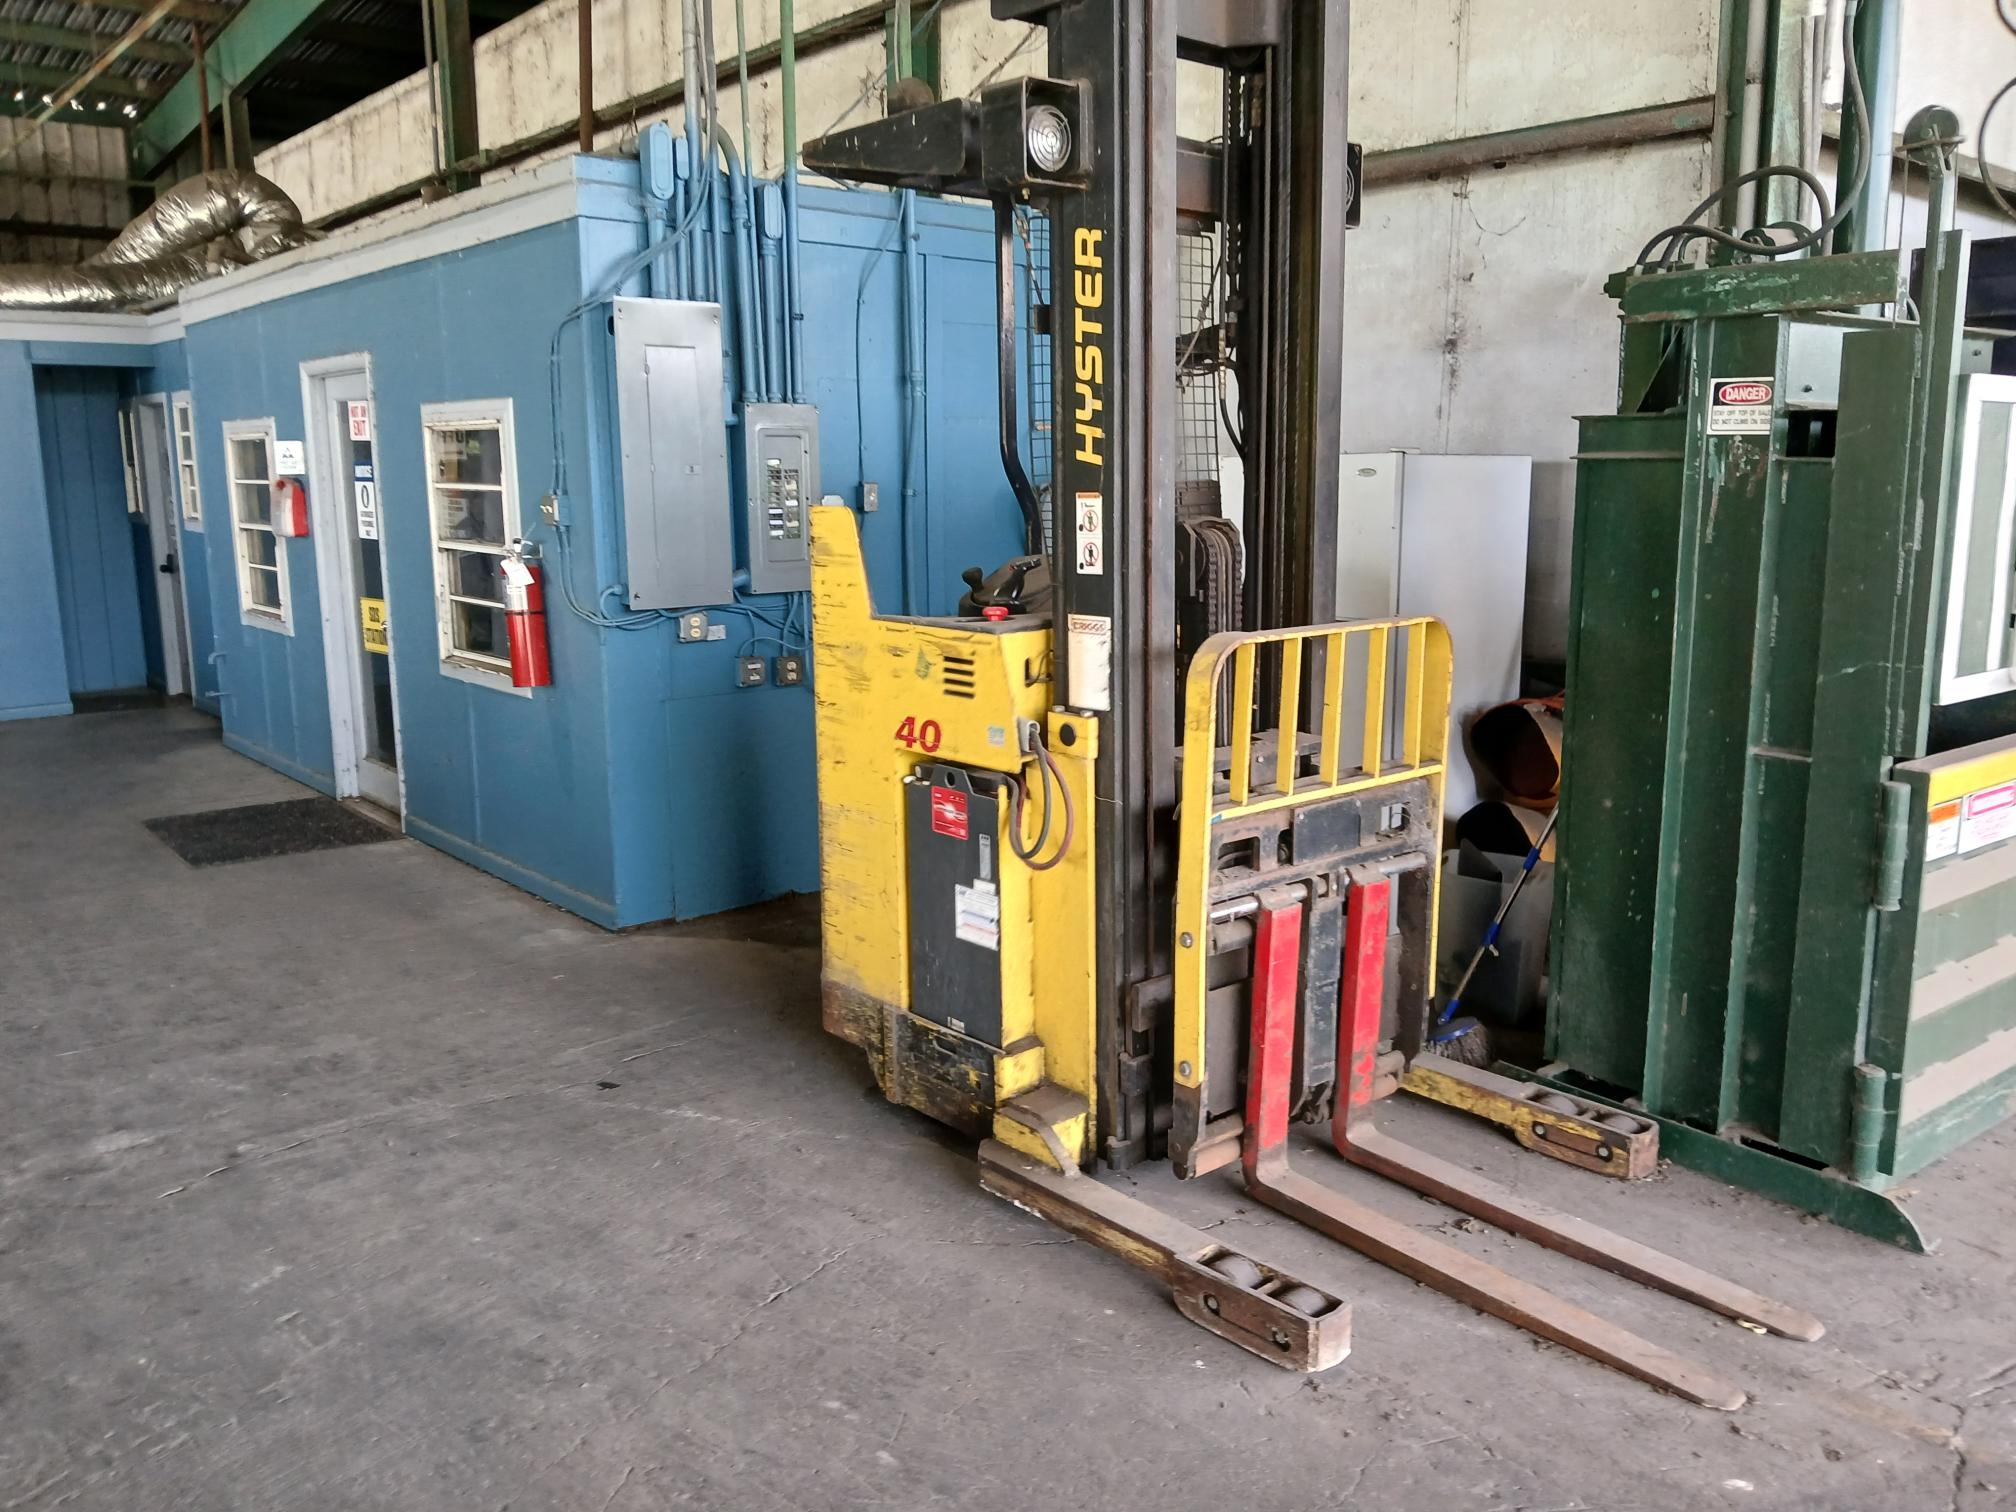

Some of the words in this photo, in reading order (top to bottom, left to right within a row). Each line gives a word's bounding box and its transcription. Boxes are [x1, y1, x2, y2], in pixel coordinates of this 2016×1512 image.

[1074, 226, 1104, 466] HYSTER
[1725, 387, 1766, 401] DANGER
[352, 419, 368, 437] EXIT
[368, 606, 381, 623] SDS
[894, 715, 942, 753] 40
